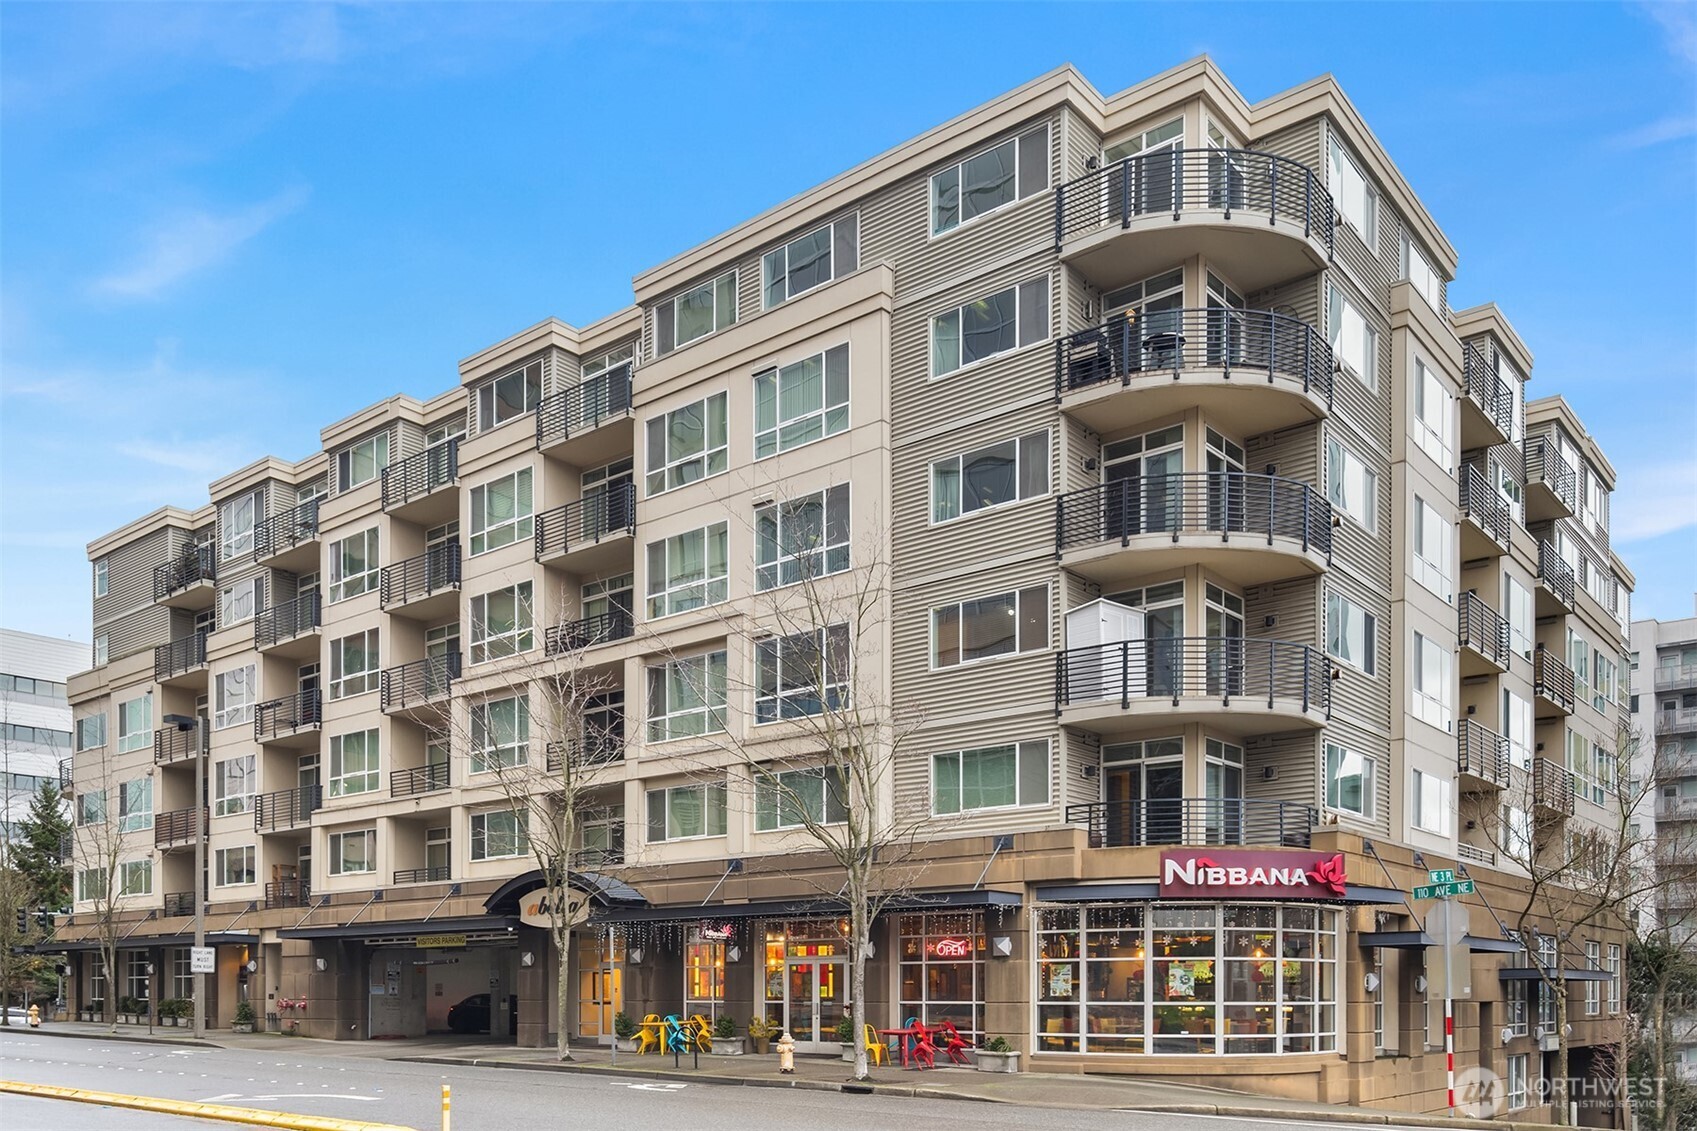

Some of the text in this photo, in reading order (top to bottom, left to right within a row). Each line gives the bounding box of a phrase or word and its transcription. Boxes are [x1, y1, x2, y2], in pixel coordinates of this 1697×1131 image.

[1165, 857, 1309, 886] NIBBANA
[1431, 871, 1453, 882] NE 3 PL
[1417, 882, 1470, 898] 110 AVE NE
[417, 935, 465, 946] VISITORS PARKING
[936, 940, 966, 956] OPEN
